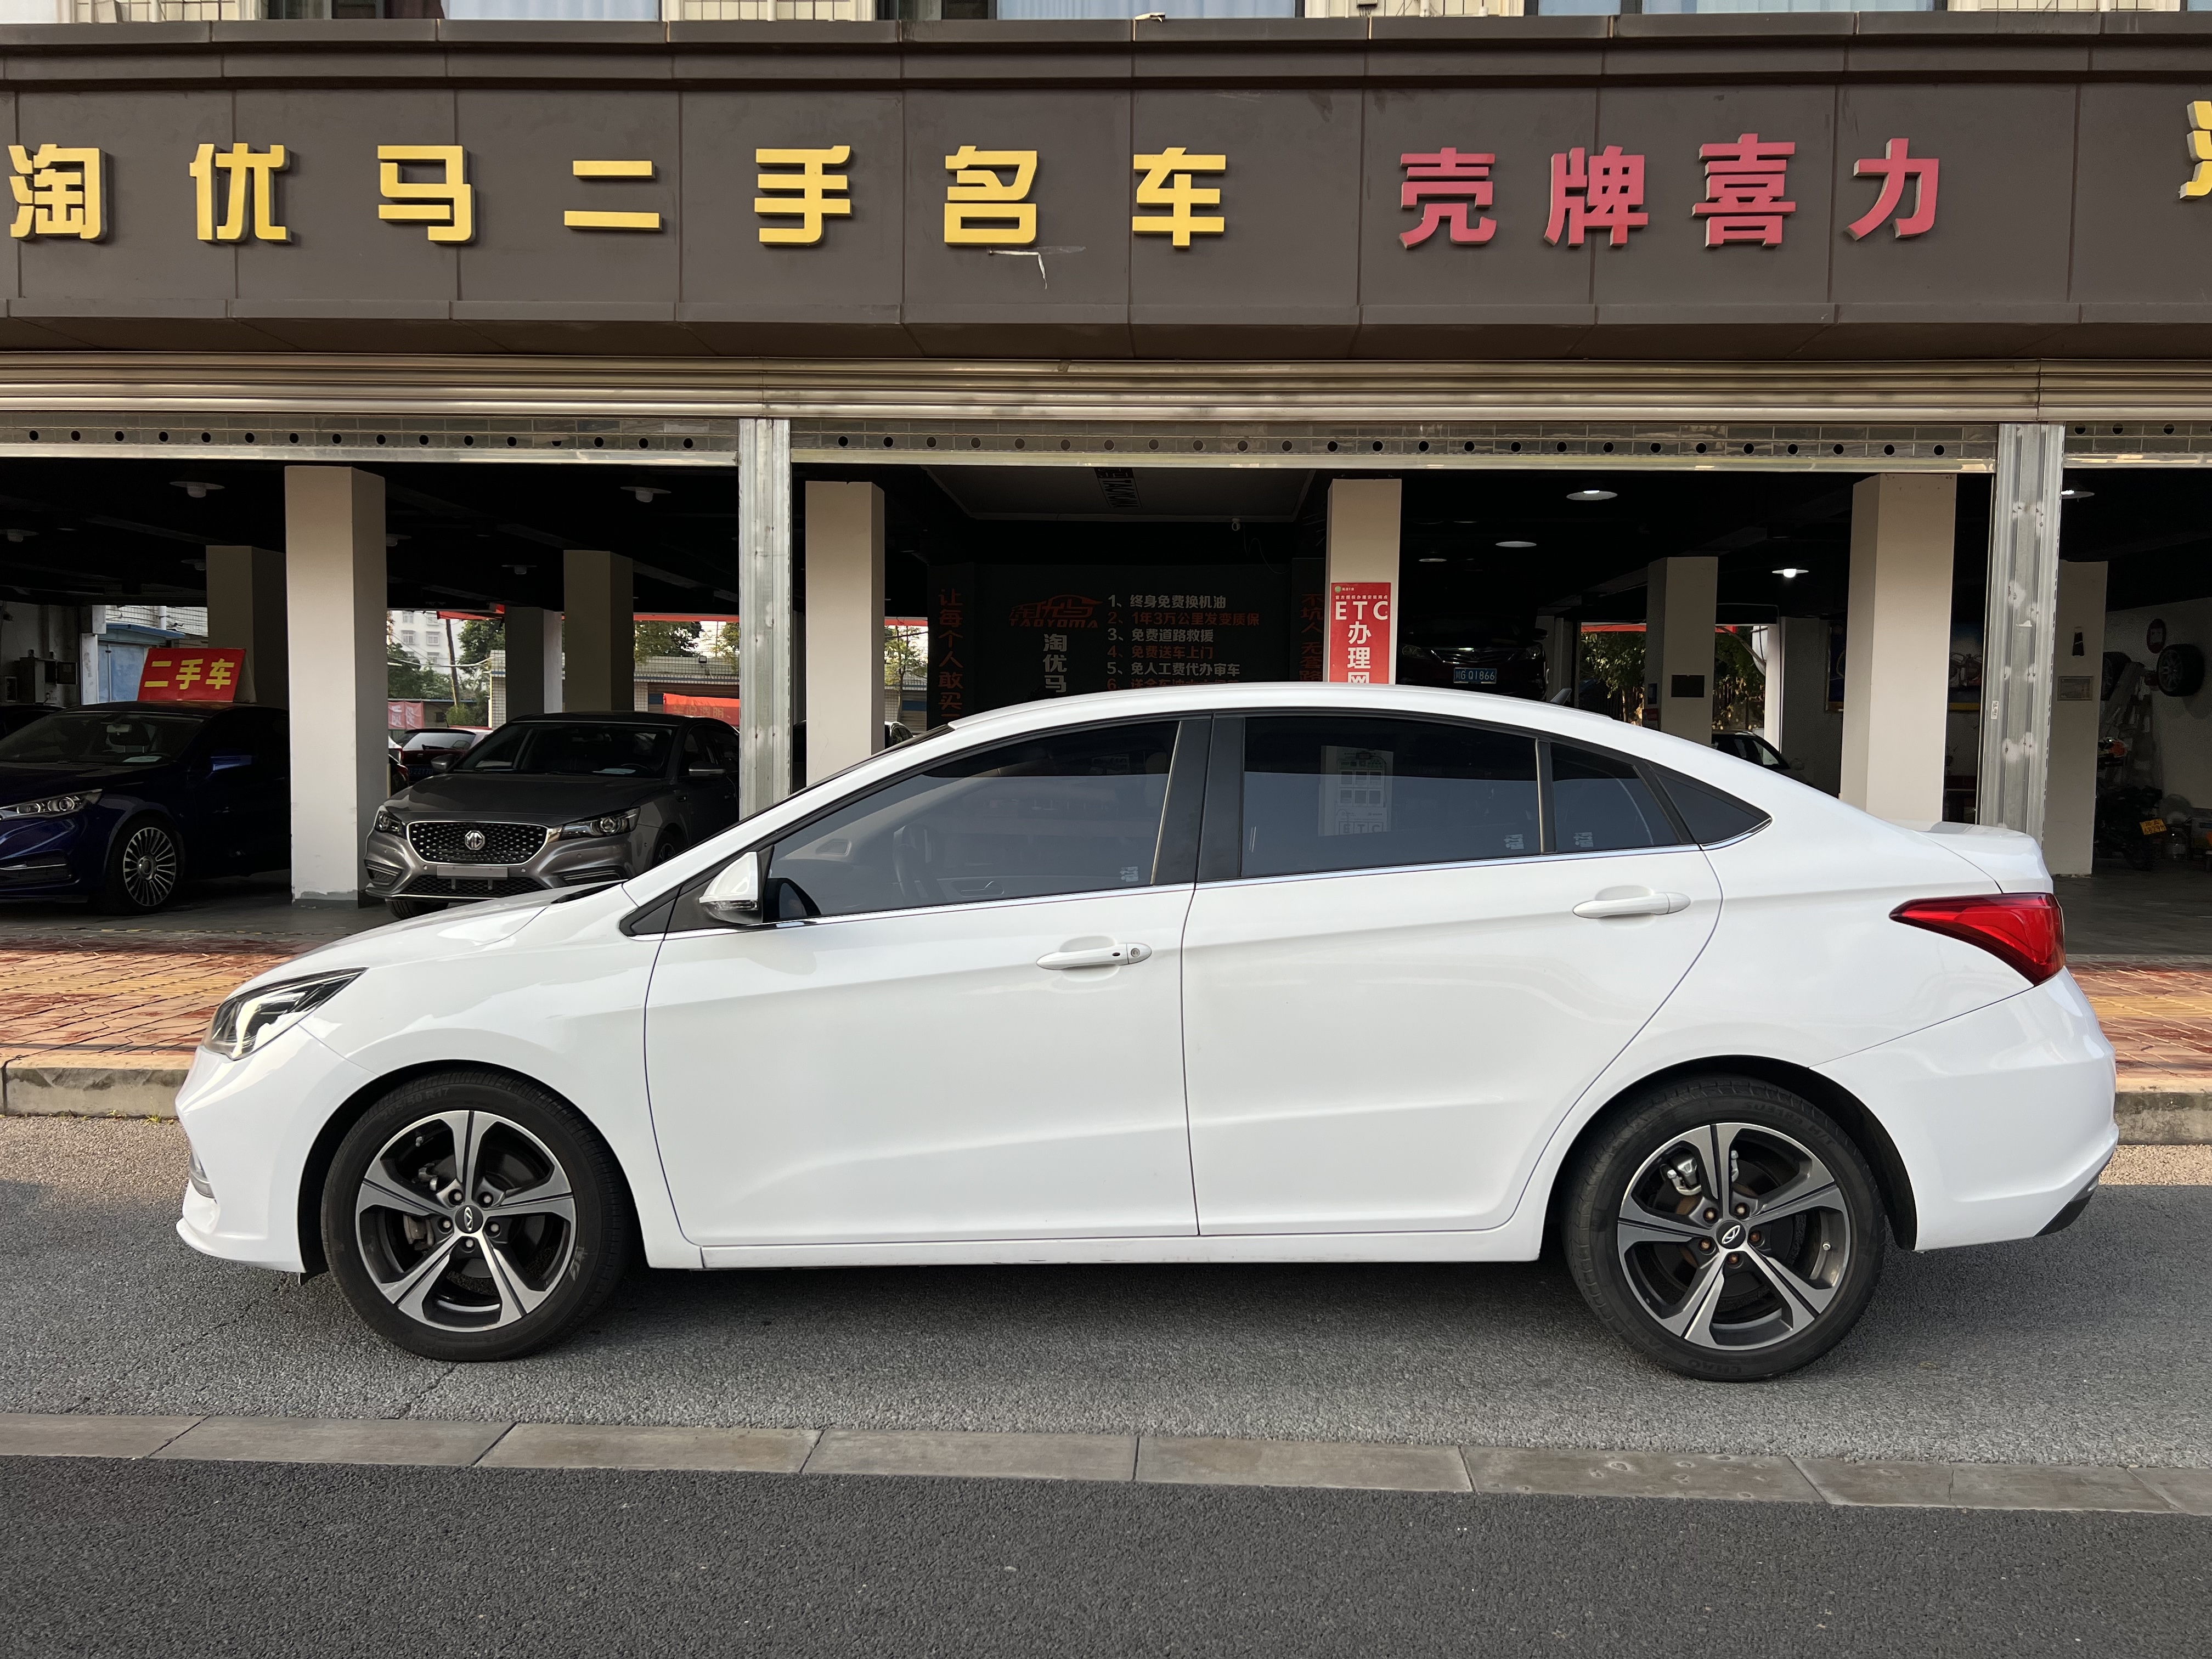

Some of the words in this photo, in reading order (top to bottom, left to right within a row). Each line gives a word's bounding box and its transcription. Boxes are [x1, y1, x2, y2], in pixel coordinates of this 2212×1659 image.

[8, 142, 1227, 249] 淘优马二手名车
[1398, 133, 1940, 249] 壳牌喜力
[1335, 601, 1389, 620] ETC
[144, 658, 235, 690] 二手车
[1042, 633, 1068, 693] 淘优马
[466, 831, 483, 849] MG
